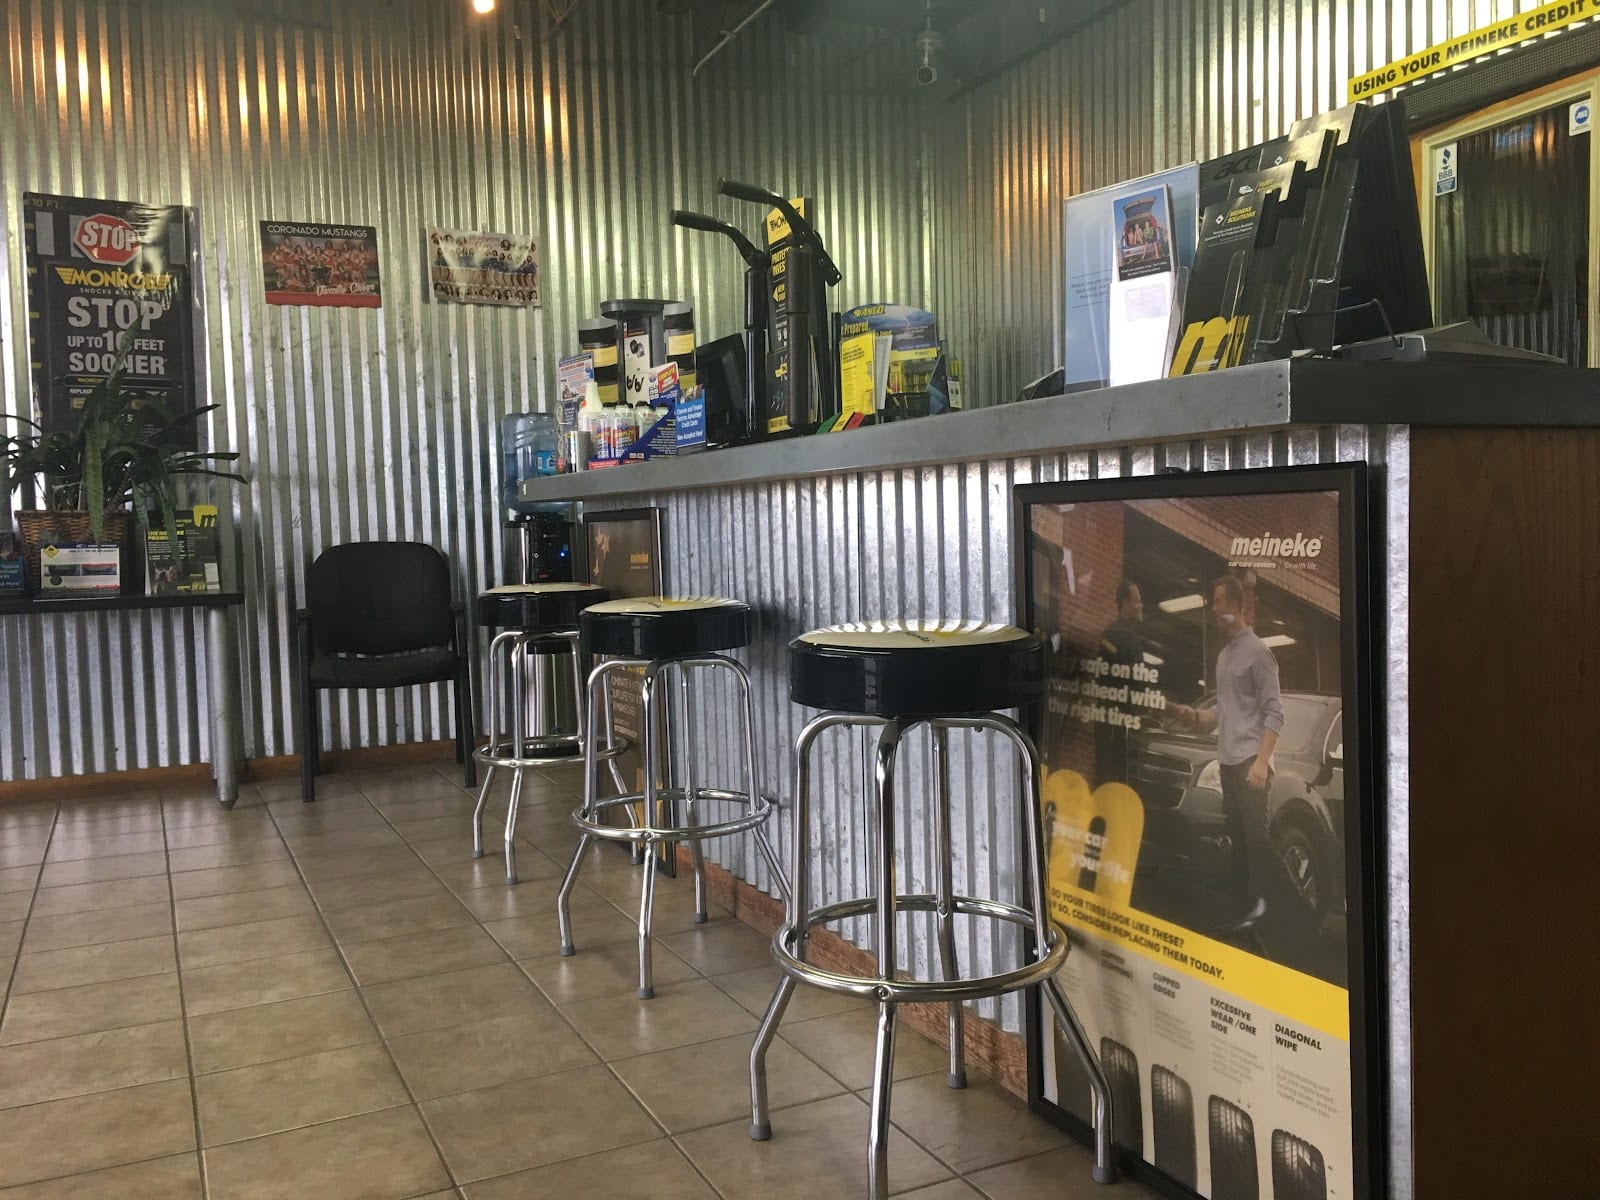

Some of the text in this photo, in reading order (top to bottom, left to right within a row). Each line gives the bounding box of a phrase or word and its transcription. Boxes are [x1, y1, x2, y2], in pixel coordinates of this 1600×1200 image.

[1352, 0, 1585, 95] USING YOUR MEINEKE CREDIT
[1438, 169, 1453, 181] BBB
[81, 220, 138, 252] STOP
[266, 224, 368, 238] CORONADO MUSTANGS
[71, 269, 162, 290] MONROE
[67, 295, 164, 332] STOP
[67, 335, 85, 348] UP
[86, 336, 104, 349] TO
[133, 338, 166, 352] FEET
[68, 351, 166, 376] SOONER
[1230, 531, 1322, 558] meineke
[1081, 656, 1110, 679] safe
[1110, 663, 1131, 679] on
[1132, 661, 1159, 683] the
[1081, 679, 1129, 703] ahead
[1130, 686, 1167, 711] with
[1070, 700, 1106, 724] right
[1106, 706, 1141, 730] tires
[1084, 831, 1108, 849] car
[1069, 850, 1101, 873] your
[1063, 892, 1084, 908] YOUR
[1084, 901, 1106, 917] TIRES
[1107, 909, 1131, 926] LOOK
[1131, 919, 1151, 936] LIKE
[1151, 927, 1185, 948] THESE?
[1058, 903, 1071, 917] SO,
[1072, 908, 1112, 931] CONSIDER
[1112, 925, 1161, 953] REPLACING
[1162, 945, 1188, 965] THEM
[1189, 956, 1225, 980] TODAY.
[1152, 972, 1181, 990] CUPPED
[1152, 982, 1176, 999] EDGES
[1210, 996, 1252, 1022] EXCESSIVE
[1210, 1007, 1234, 1027] WEAR
[1210, 1019, 1229, 1035] SIDE
[1274, 1022, 1323, 1051] DIAGONAL
[1275, 1034, 1298, 1053] WIPE
